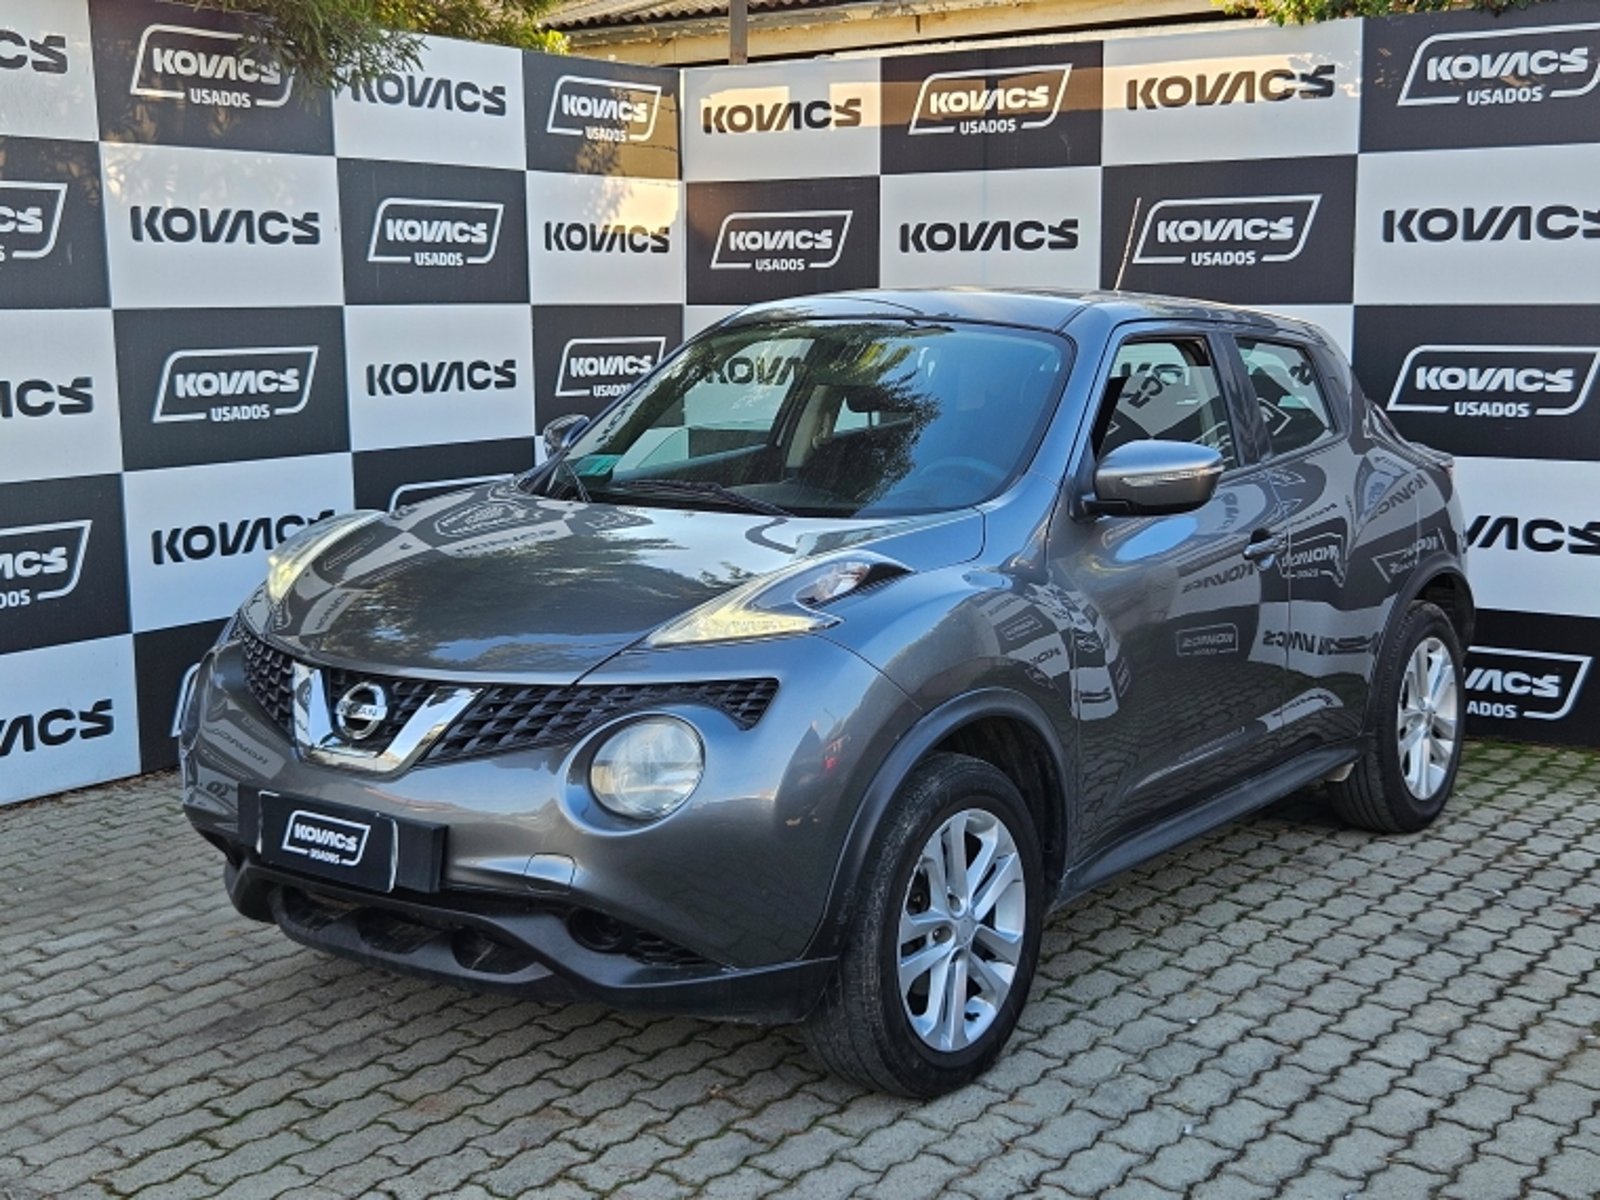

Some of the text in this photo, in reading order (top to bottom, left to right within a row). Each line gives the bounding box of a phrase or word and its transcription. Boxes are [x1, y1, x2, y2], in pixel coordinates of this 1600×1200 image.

[151, 47, 282, 84] KOVACS
[1426, 47, 1588, 82] KOVACS
[190, 87, 252, 108] USADOS
[928, 83, 1049, 114] KOVACS
[1126, 64, 1336, 110] KOVACS
[1466, 85, 1544, 106] USADOS
[560, 92, 648, 124] KOVACS
[702, 97, 862, 135] KOVACS
[585, 128, 628, 142] USADOS
[959, 118, 1017, 135] USADOS
[129, 205, 321, 245] KOVACS
[385, 218, 488, 244] KOVACS
[544, 221, 670, 254] KOVACS
[899, 218, 1079, 253] KOVACS
[1157, 216, 1294, 243] KOVACS
[729, 229, 833, 251] KOVACS
[414, 251, 464, 267] USADOS
[755, 258, 805, 272] USADOS
[1191, 250, 1256, 266] USADOS
[366, 359, 517, 397] KOVACS
[568, 354, 653, 379] KOVACS
[1415, 366, 1574, 393] KOVACS
[175, 368, 300, 398] KOVACS
[210, 403, 271, 422] USADOS
[1454, 401, 1530, 418] USADOS
[1466, 700, 1517, 719] ADOS
[294, 822, 357, 852] KOVACS
